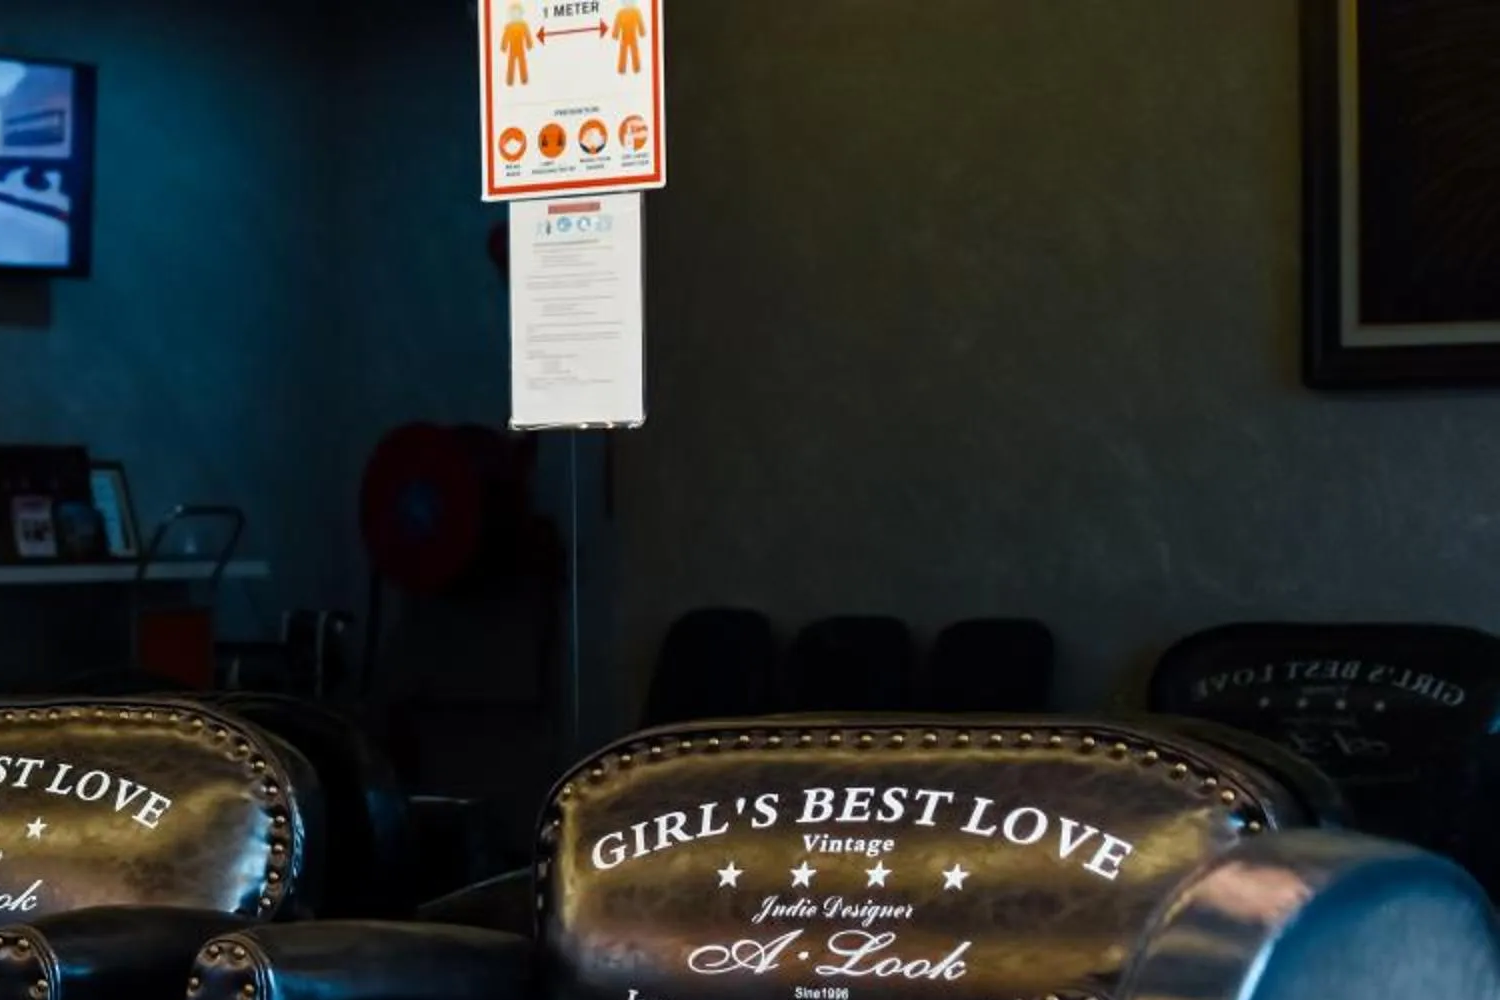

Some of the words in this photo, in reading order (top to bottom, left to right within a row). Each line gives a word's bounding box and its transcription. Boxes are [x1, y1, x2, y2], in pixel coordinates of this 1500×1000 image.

[553, 1, 599, 17] METER
[46, 763, 172, 830] LOVE
[591, 793, 780, 870] GIRL'S
[795, 787, 952, 825] BEST
[963, 798, 1134, 880] LOVE
[802, 834, 894, 857] Vintage
[822, 895, 913, 928] Designer
